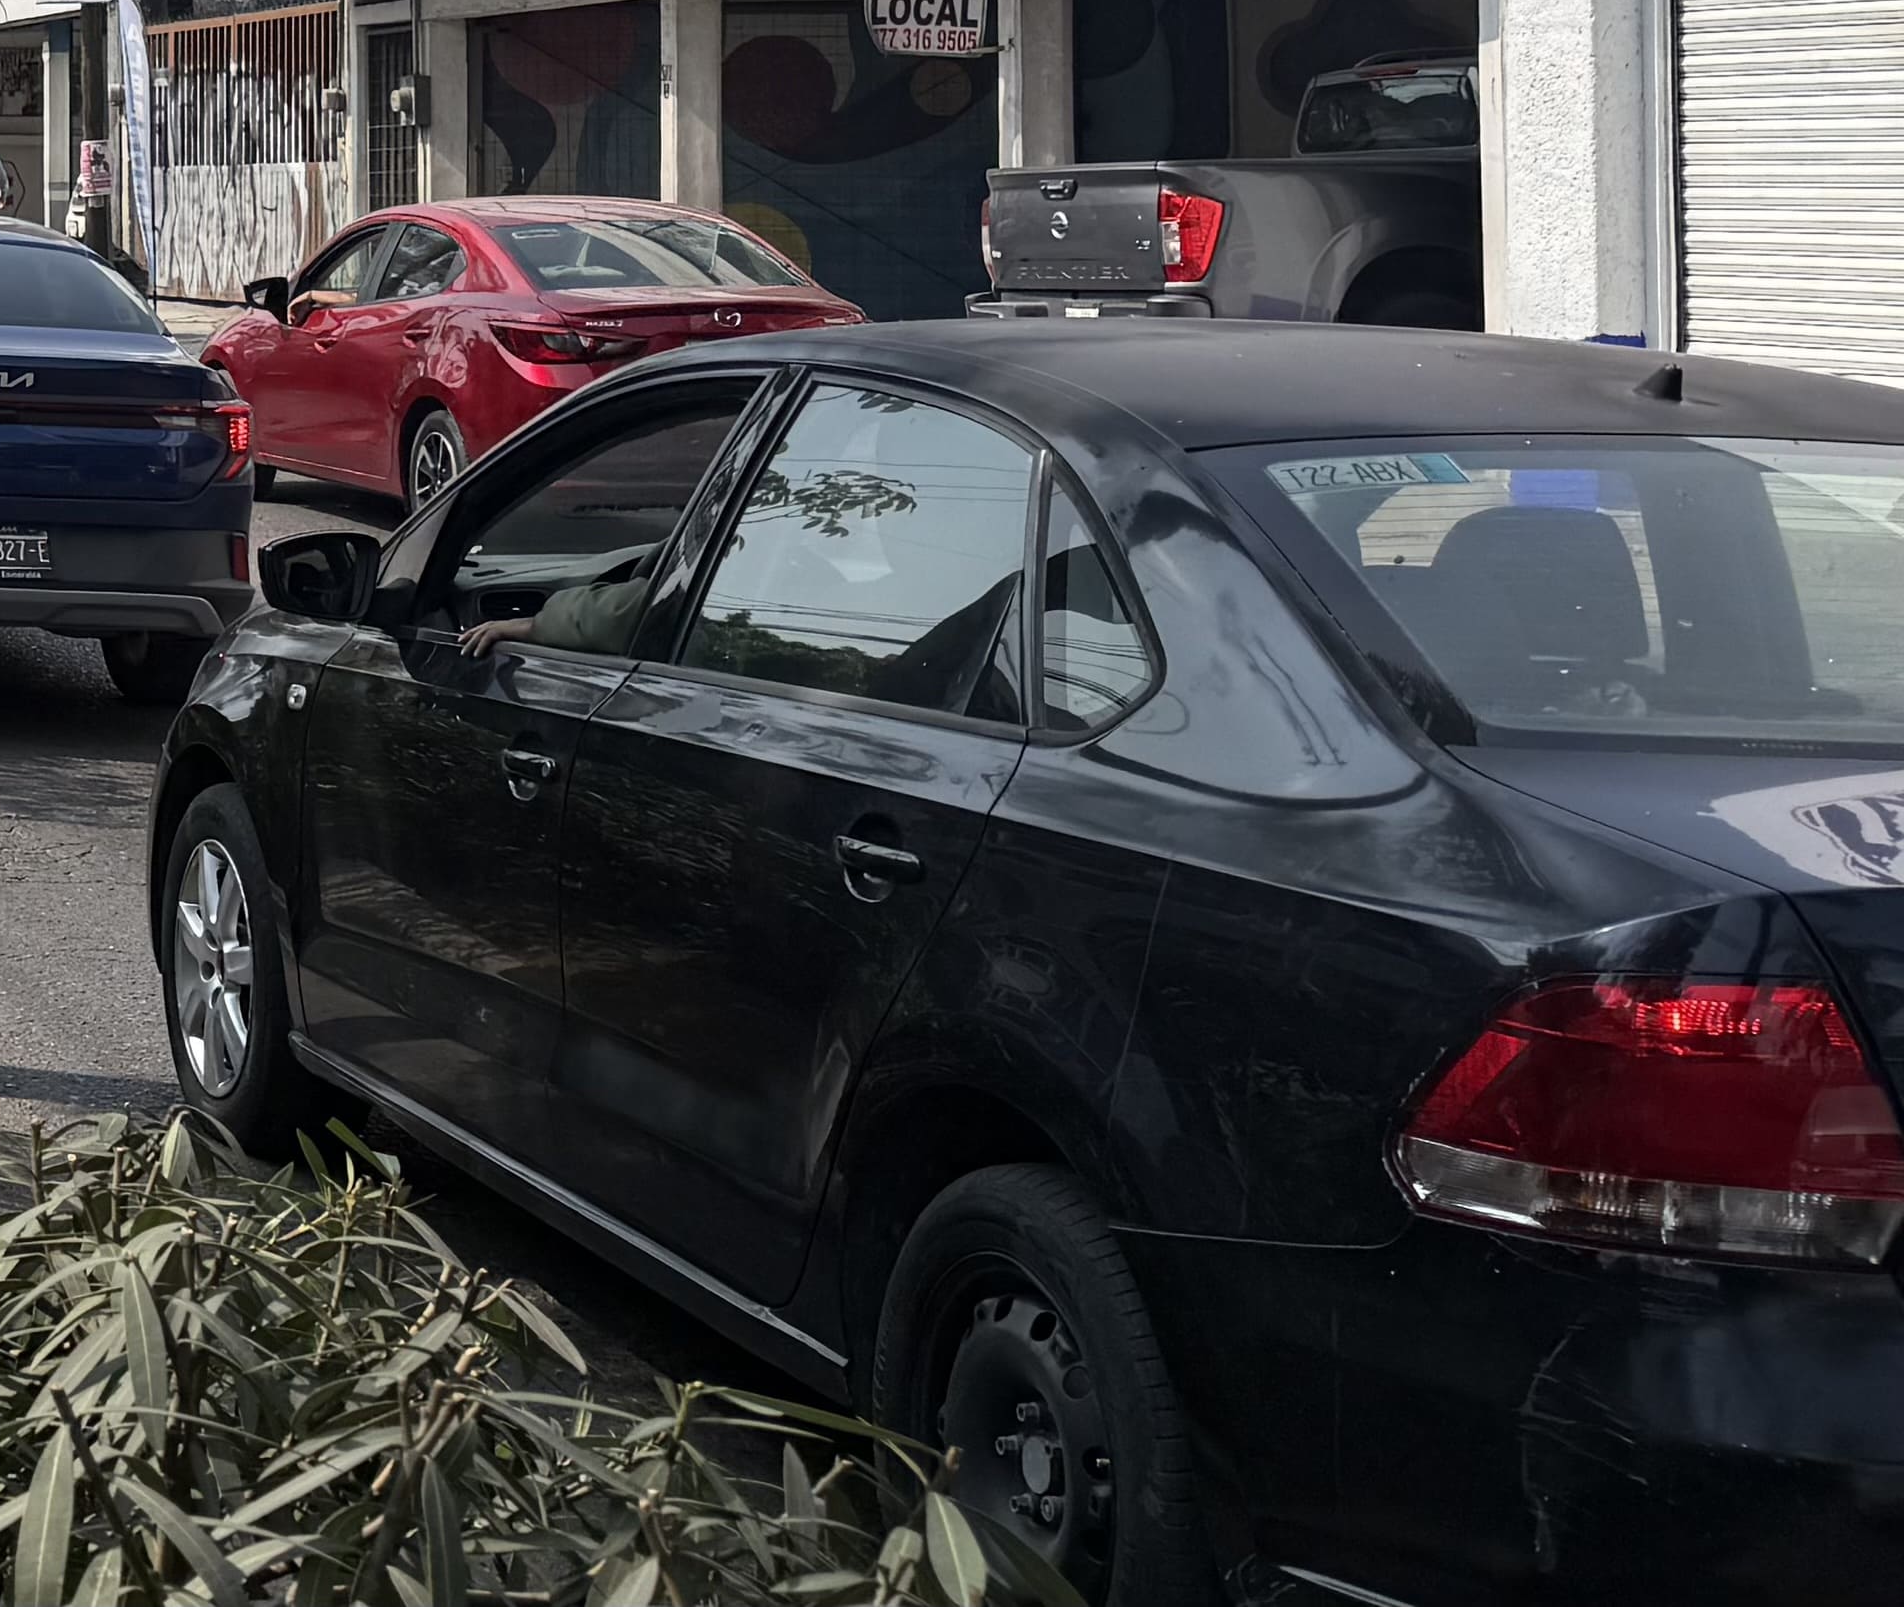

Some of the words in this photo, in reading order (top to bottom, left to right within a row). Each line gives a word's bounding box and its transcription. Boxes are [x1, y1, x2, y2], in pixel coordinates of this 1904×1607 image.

[903, 28, 932, 50] 316
[937, 29, 977, 52] 9505
[1280, 460, 1416, 489] T22-ABX
